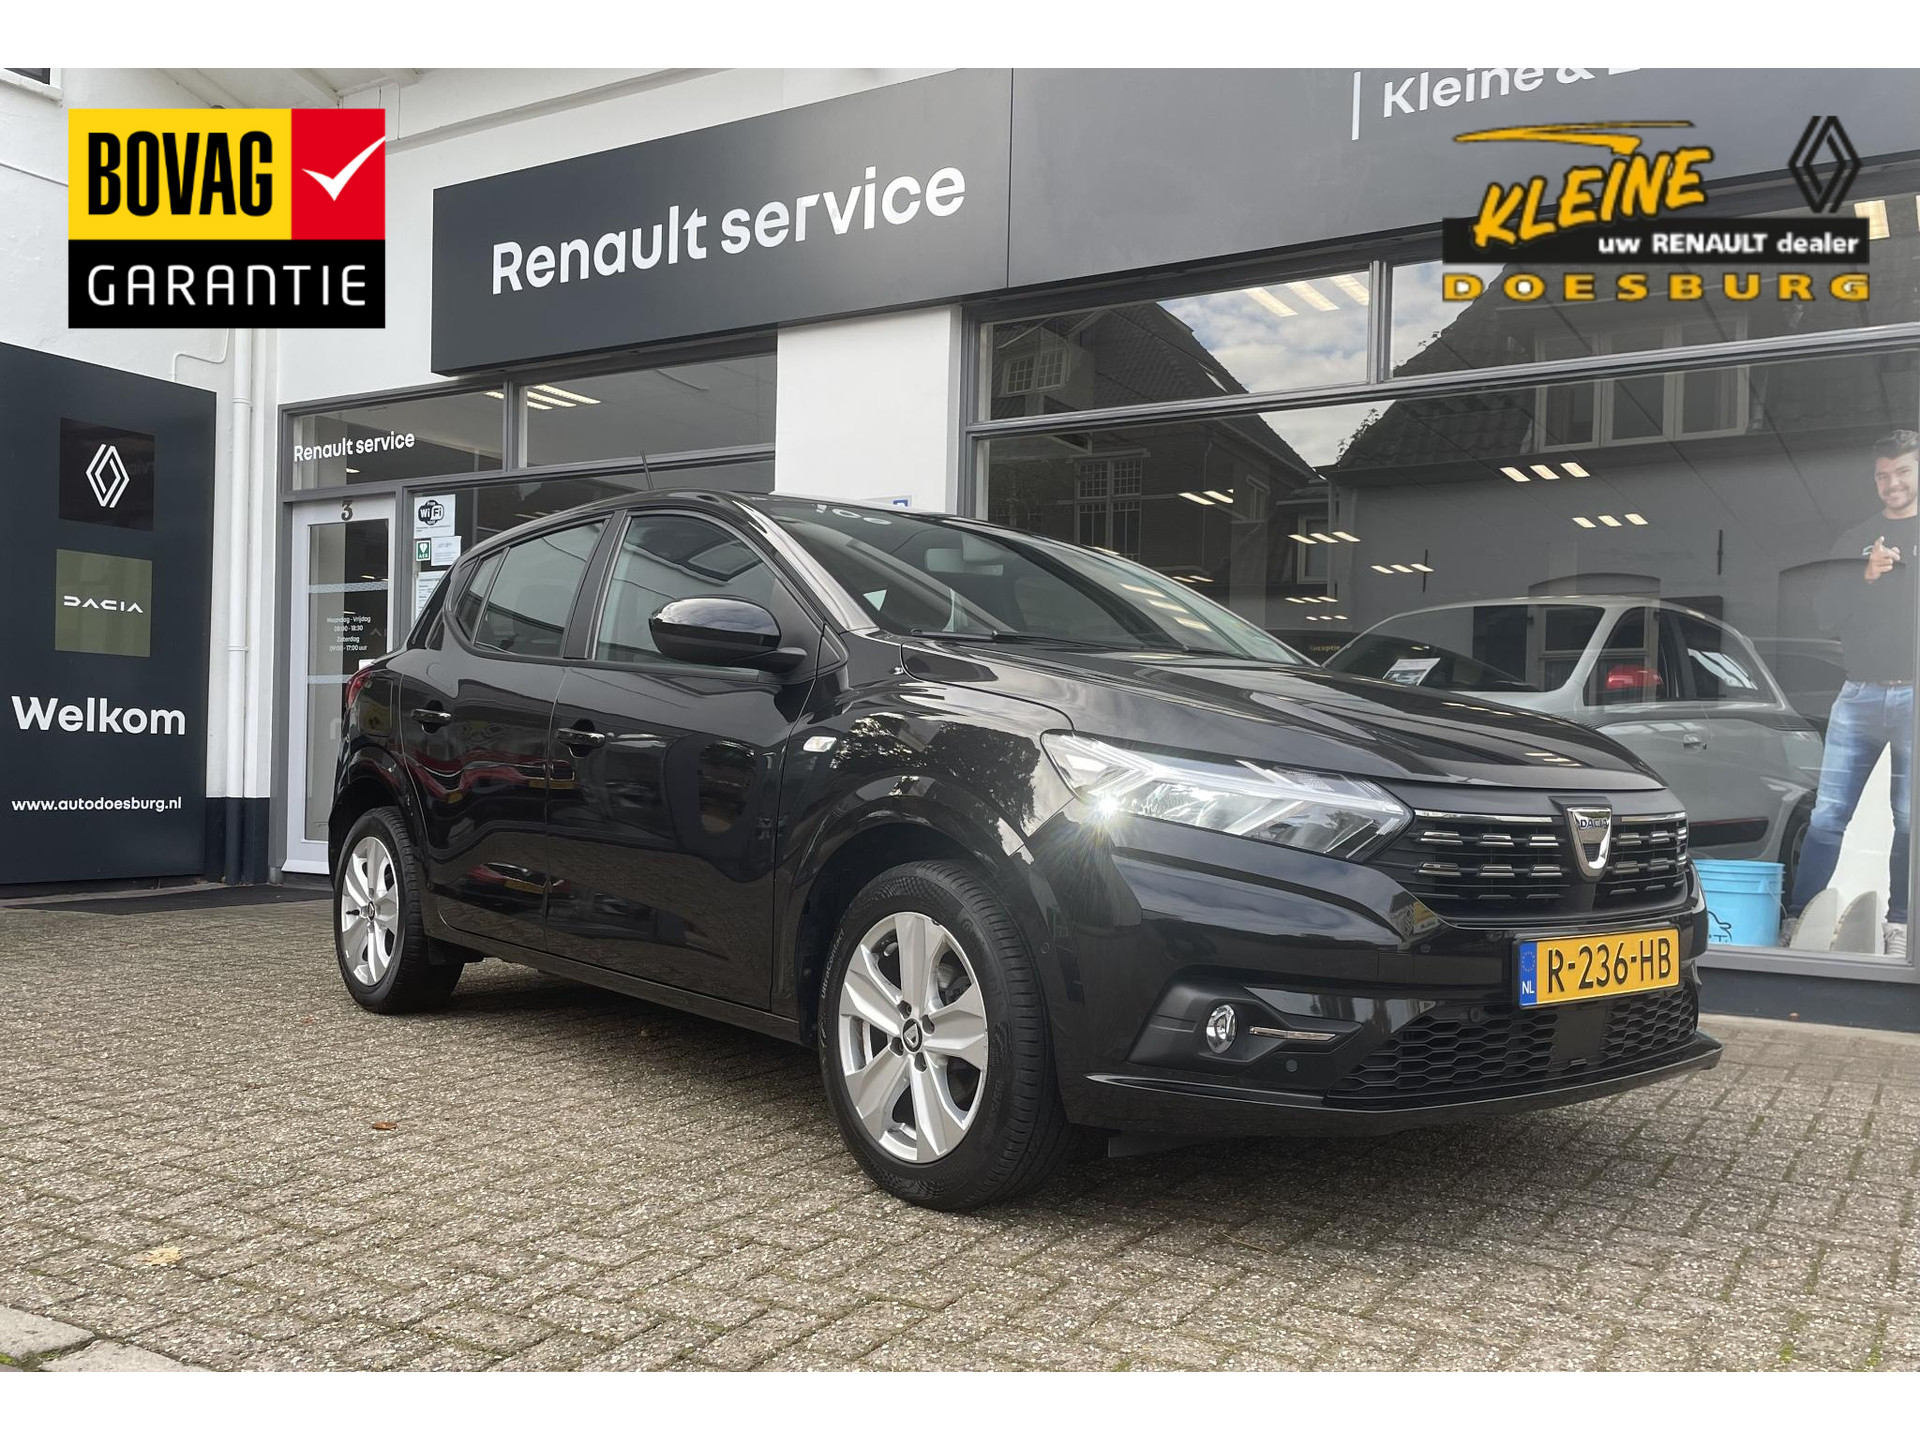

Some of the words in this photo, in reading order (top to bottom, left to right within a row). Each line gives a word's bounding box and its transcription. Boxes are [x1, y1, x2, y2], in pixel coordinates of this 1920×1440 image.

[1383, 68, 1544, 118] Kleine
[492, 205, 708, 296] Renault
[721, 165, 966, 254] service
[294, 437, 353, 462] Renault
[355, 430, 415, 454] service
[341, 496, 354, 521] 3
[63, 595, 144, 613] DACIA
[11, 695, 186, 735] Welkom
[11, 797, 182, 813] www.autodoesburg.nl
[1521, 981, 1535, 995] NL
[1548, 937, 1672, 993] R-236-HB
